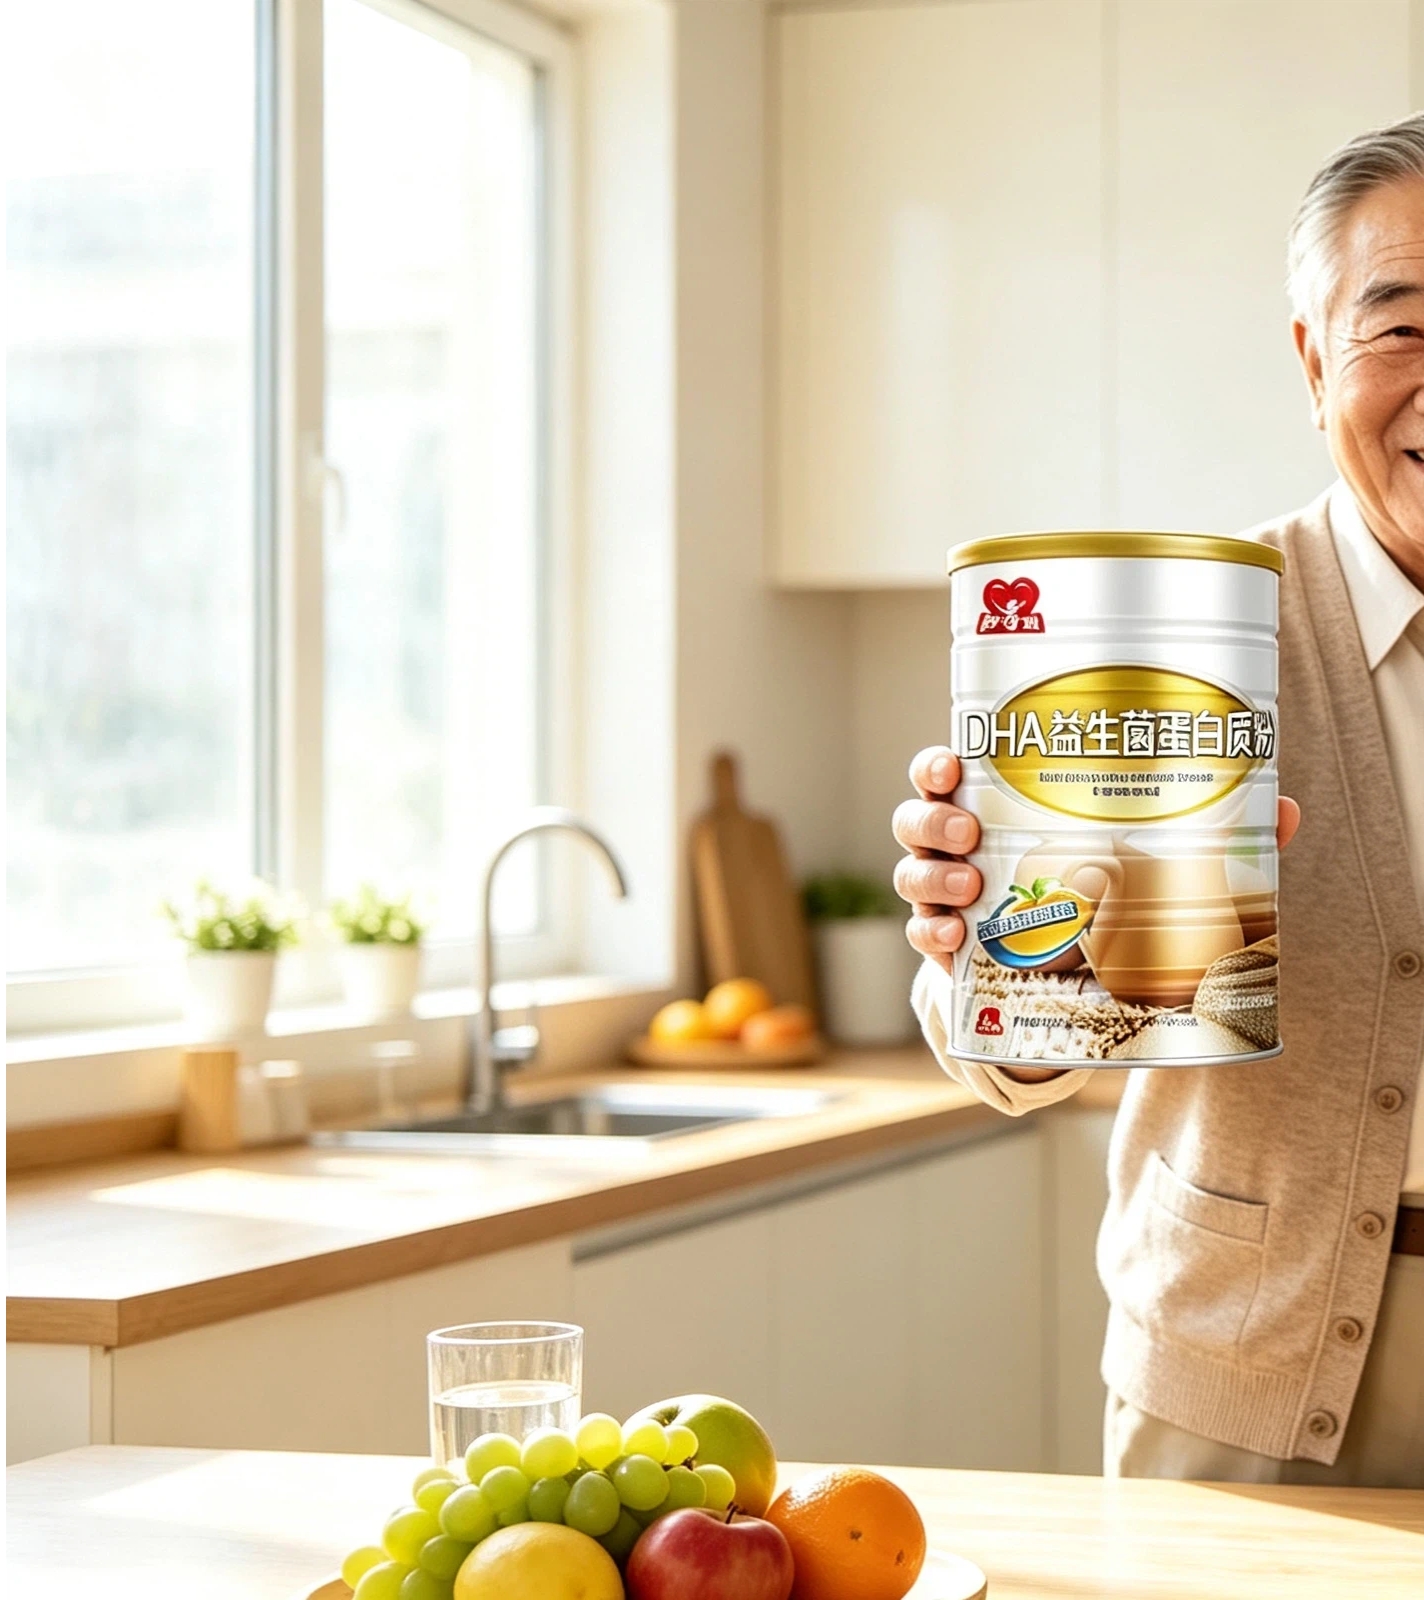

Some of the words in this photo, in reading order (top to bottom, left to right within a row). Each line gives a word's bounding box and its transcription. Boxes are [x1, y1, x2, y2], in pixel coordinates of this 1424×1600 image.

[960, 709, 1273, 758] DHA益生菌蛋白质粉
